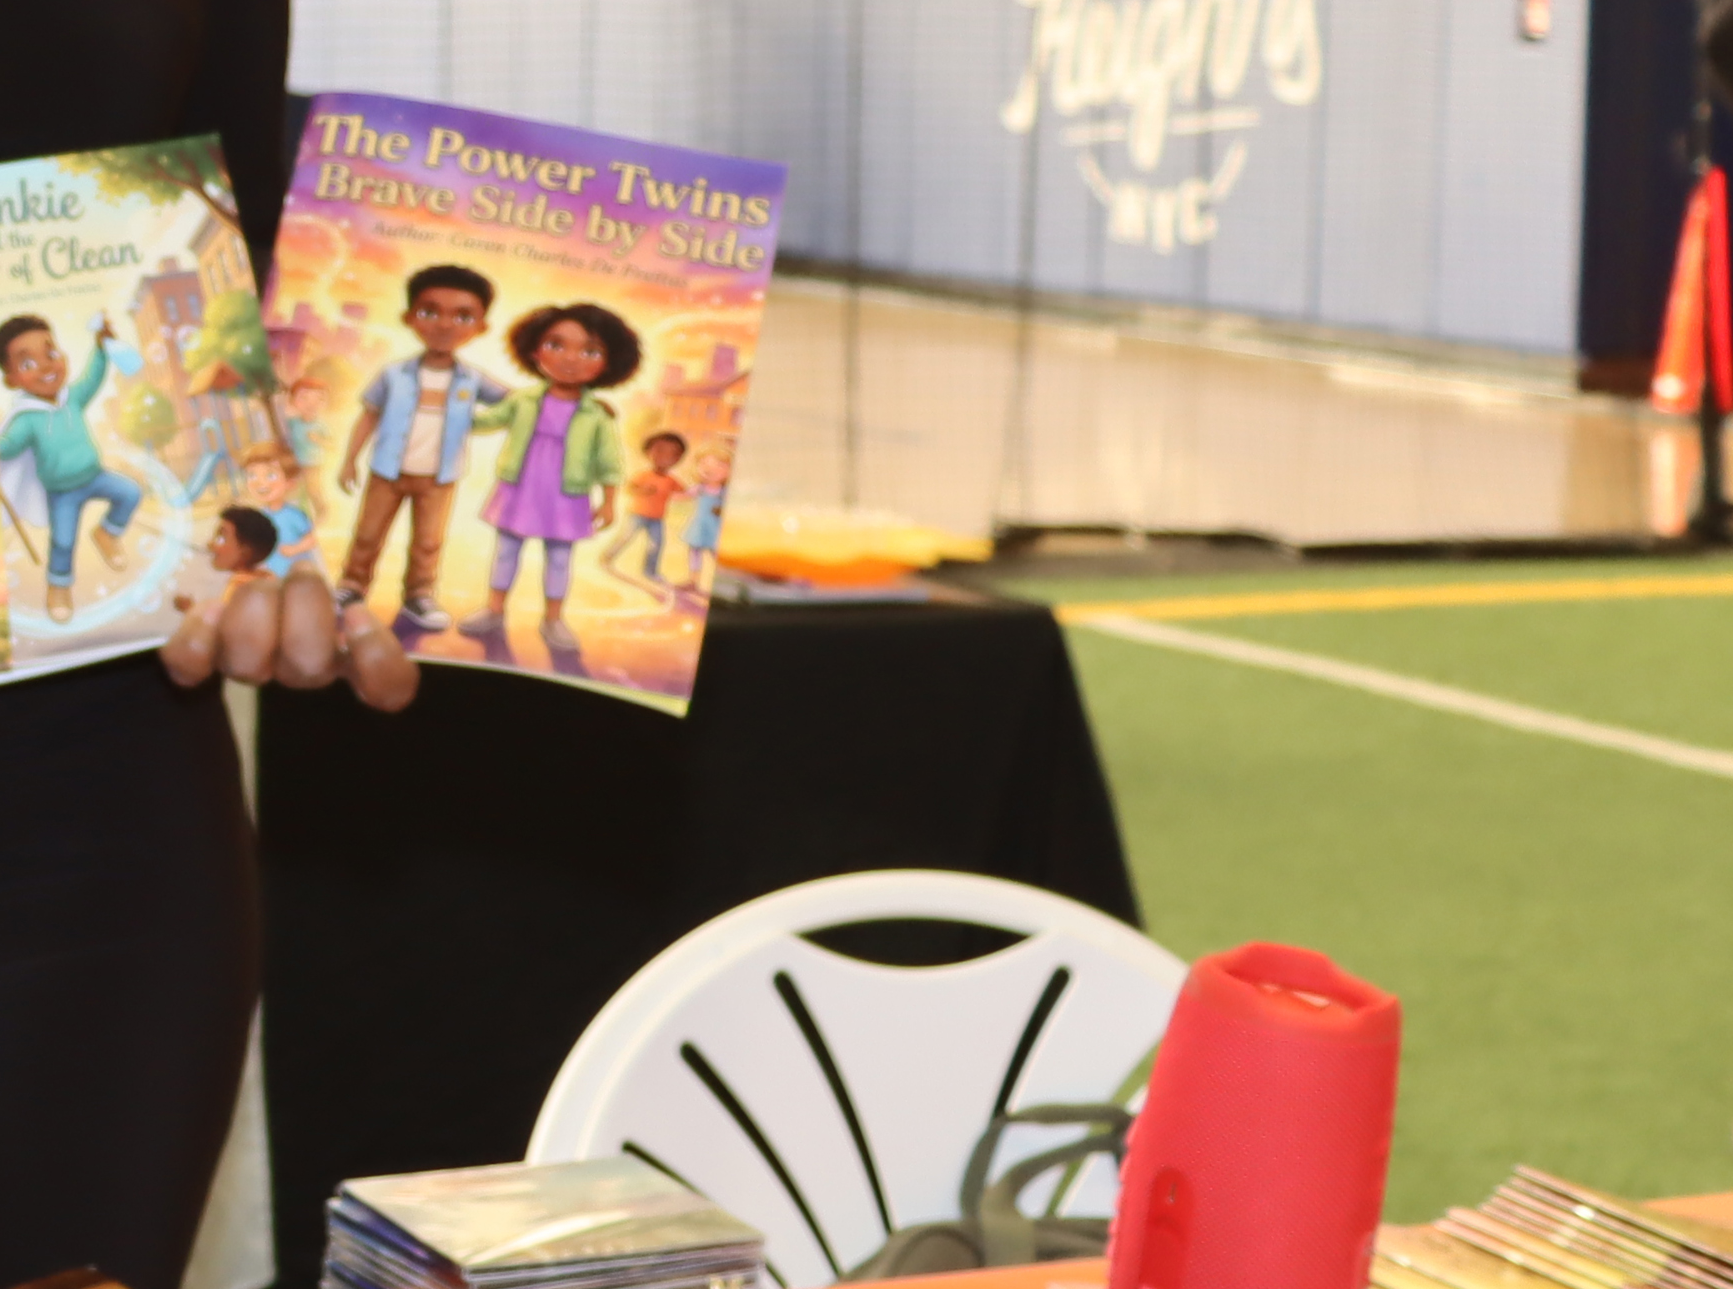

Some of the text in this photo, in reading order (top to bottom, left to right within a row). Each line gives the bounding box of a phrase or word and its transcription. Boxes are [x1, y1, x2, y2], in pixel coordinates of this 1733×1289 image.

[315, 162, 767, 273] Brave Side by Side
[316, 114, 772, 228] The Power Twins
[10, 252, 33, 285] of
[42, 235, 143, 280] Clean
